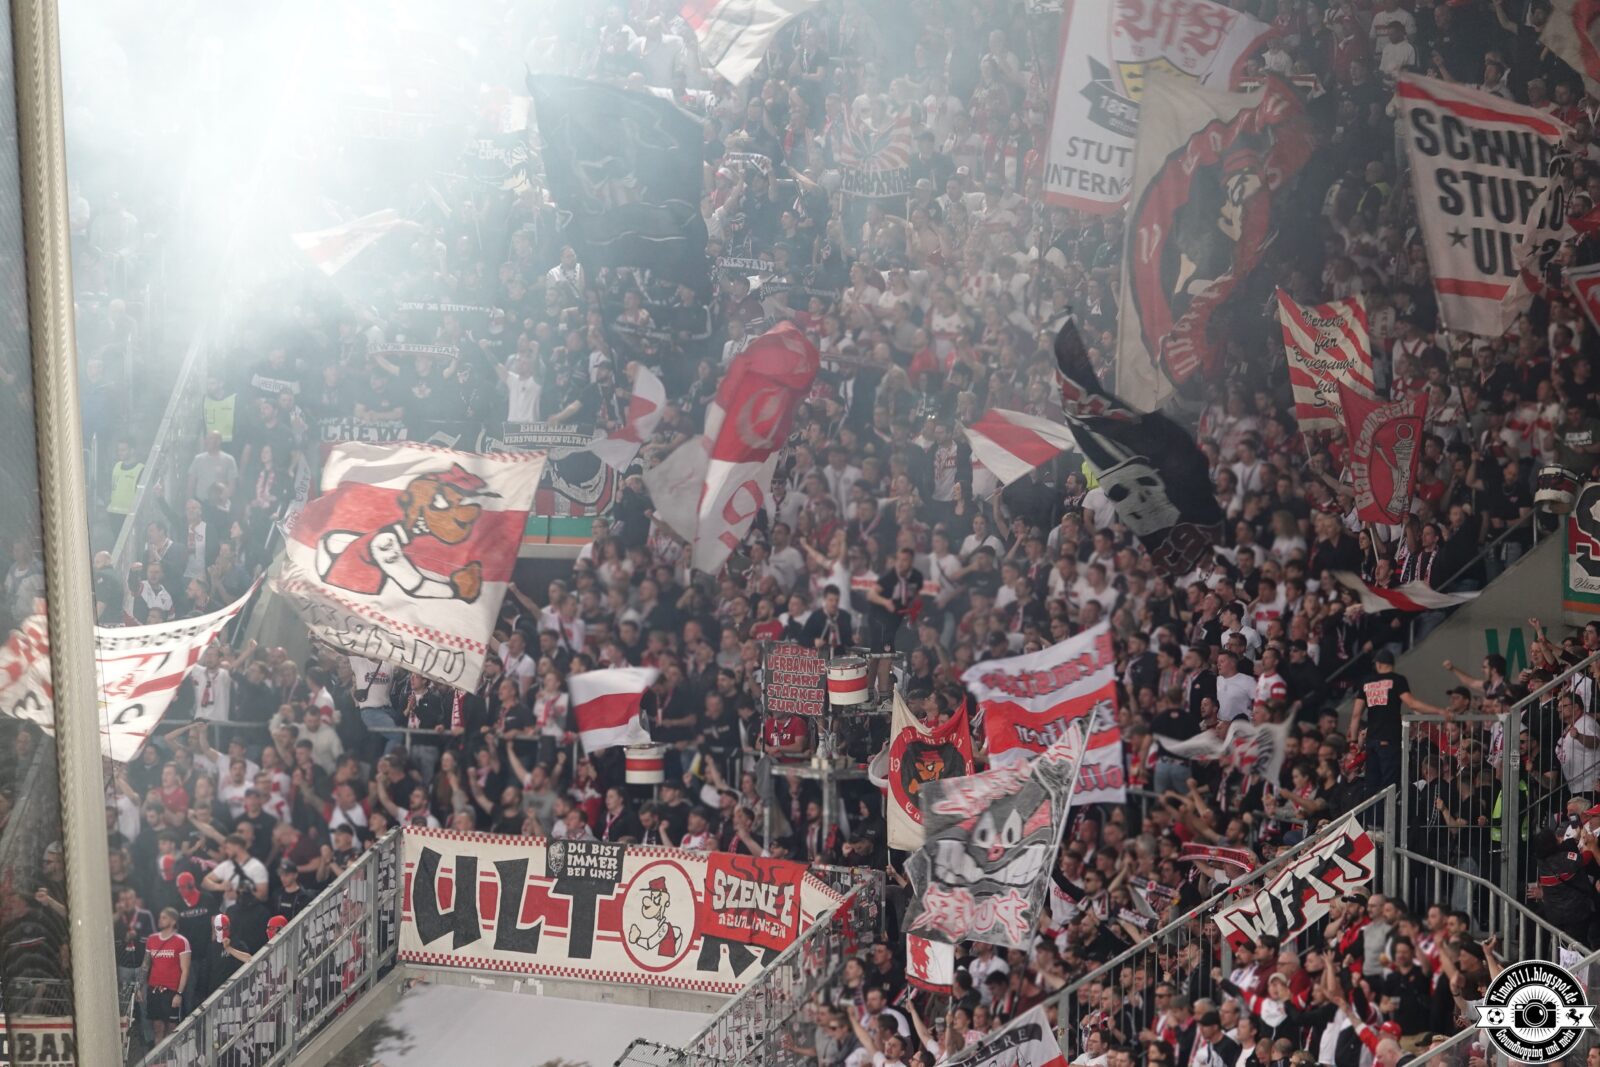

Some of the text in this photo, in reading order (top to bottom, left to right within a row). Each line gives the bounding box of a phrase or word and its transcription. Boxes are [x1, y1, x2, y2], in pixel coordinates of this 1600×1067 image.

[773, 643, 819, 658] JEDER
[767, 653, 826, 675] VERBANNTE
[773, 670, 821, 688] KEHRT
[889, 756, 902, 774] 19
[567, 842, 621, 857] DU BIST
[567, 854, 618, 870] IMMER
[567, 867, 619, 880] BEI UNS!
